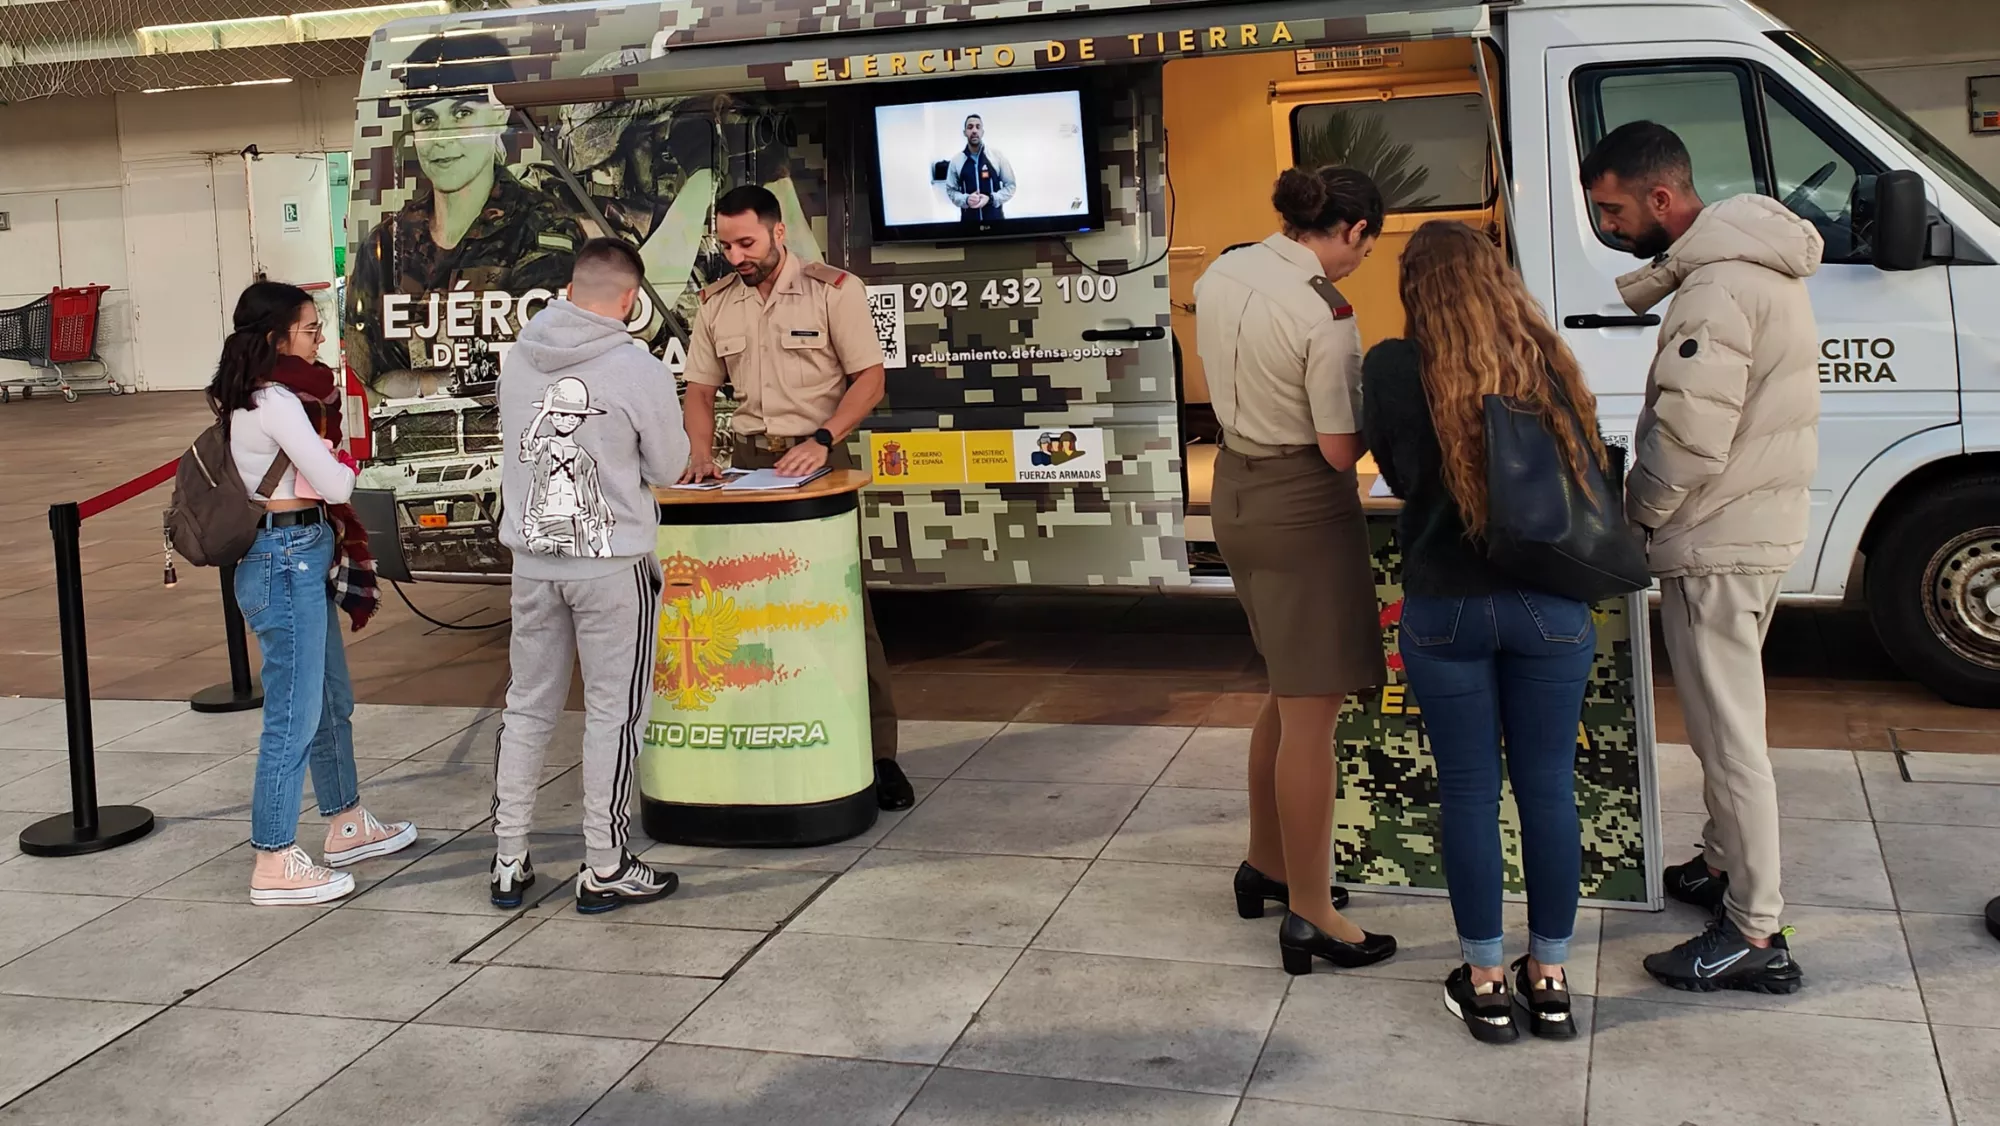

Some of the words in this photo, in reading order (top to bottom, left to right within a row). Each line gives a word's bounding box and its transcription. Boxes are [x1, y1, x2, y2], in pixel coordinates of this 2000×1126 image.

[812, 45, 1015, 80] EJÉRCITO
[1047, 38, 1096, 62] DE
[1128, 21, 1293, 55] TIERRA
[910, 281, 968, 308] 902
[981, 277, 1041, 305] 432
[1056, 275, 1117, 302] 100
[383, 280, 653, 338] EJÉRCO
[433, 343, 469, 367] DE
[911, 346, 1122, 363] reclutamiento.defensa.gob.es
[1818, 338, 1895, 359] CITO
[1019, 472, 1057, 480] FUERZAS
[1059, 470, 1101, 479] ARMADAS
[690, 726, 725, 744] DE
[731, 723, 825, 745] TIERRA
